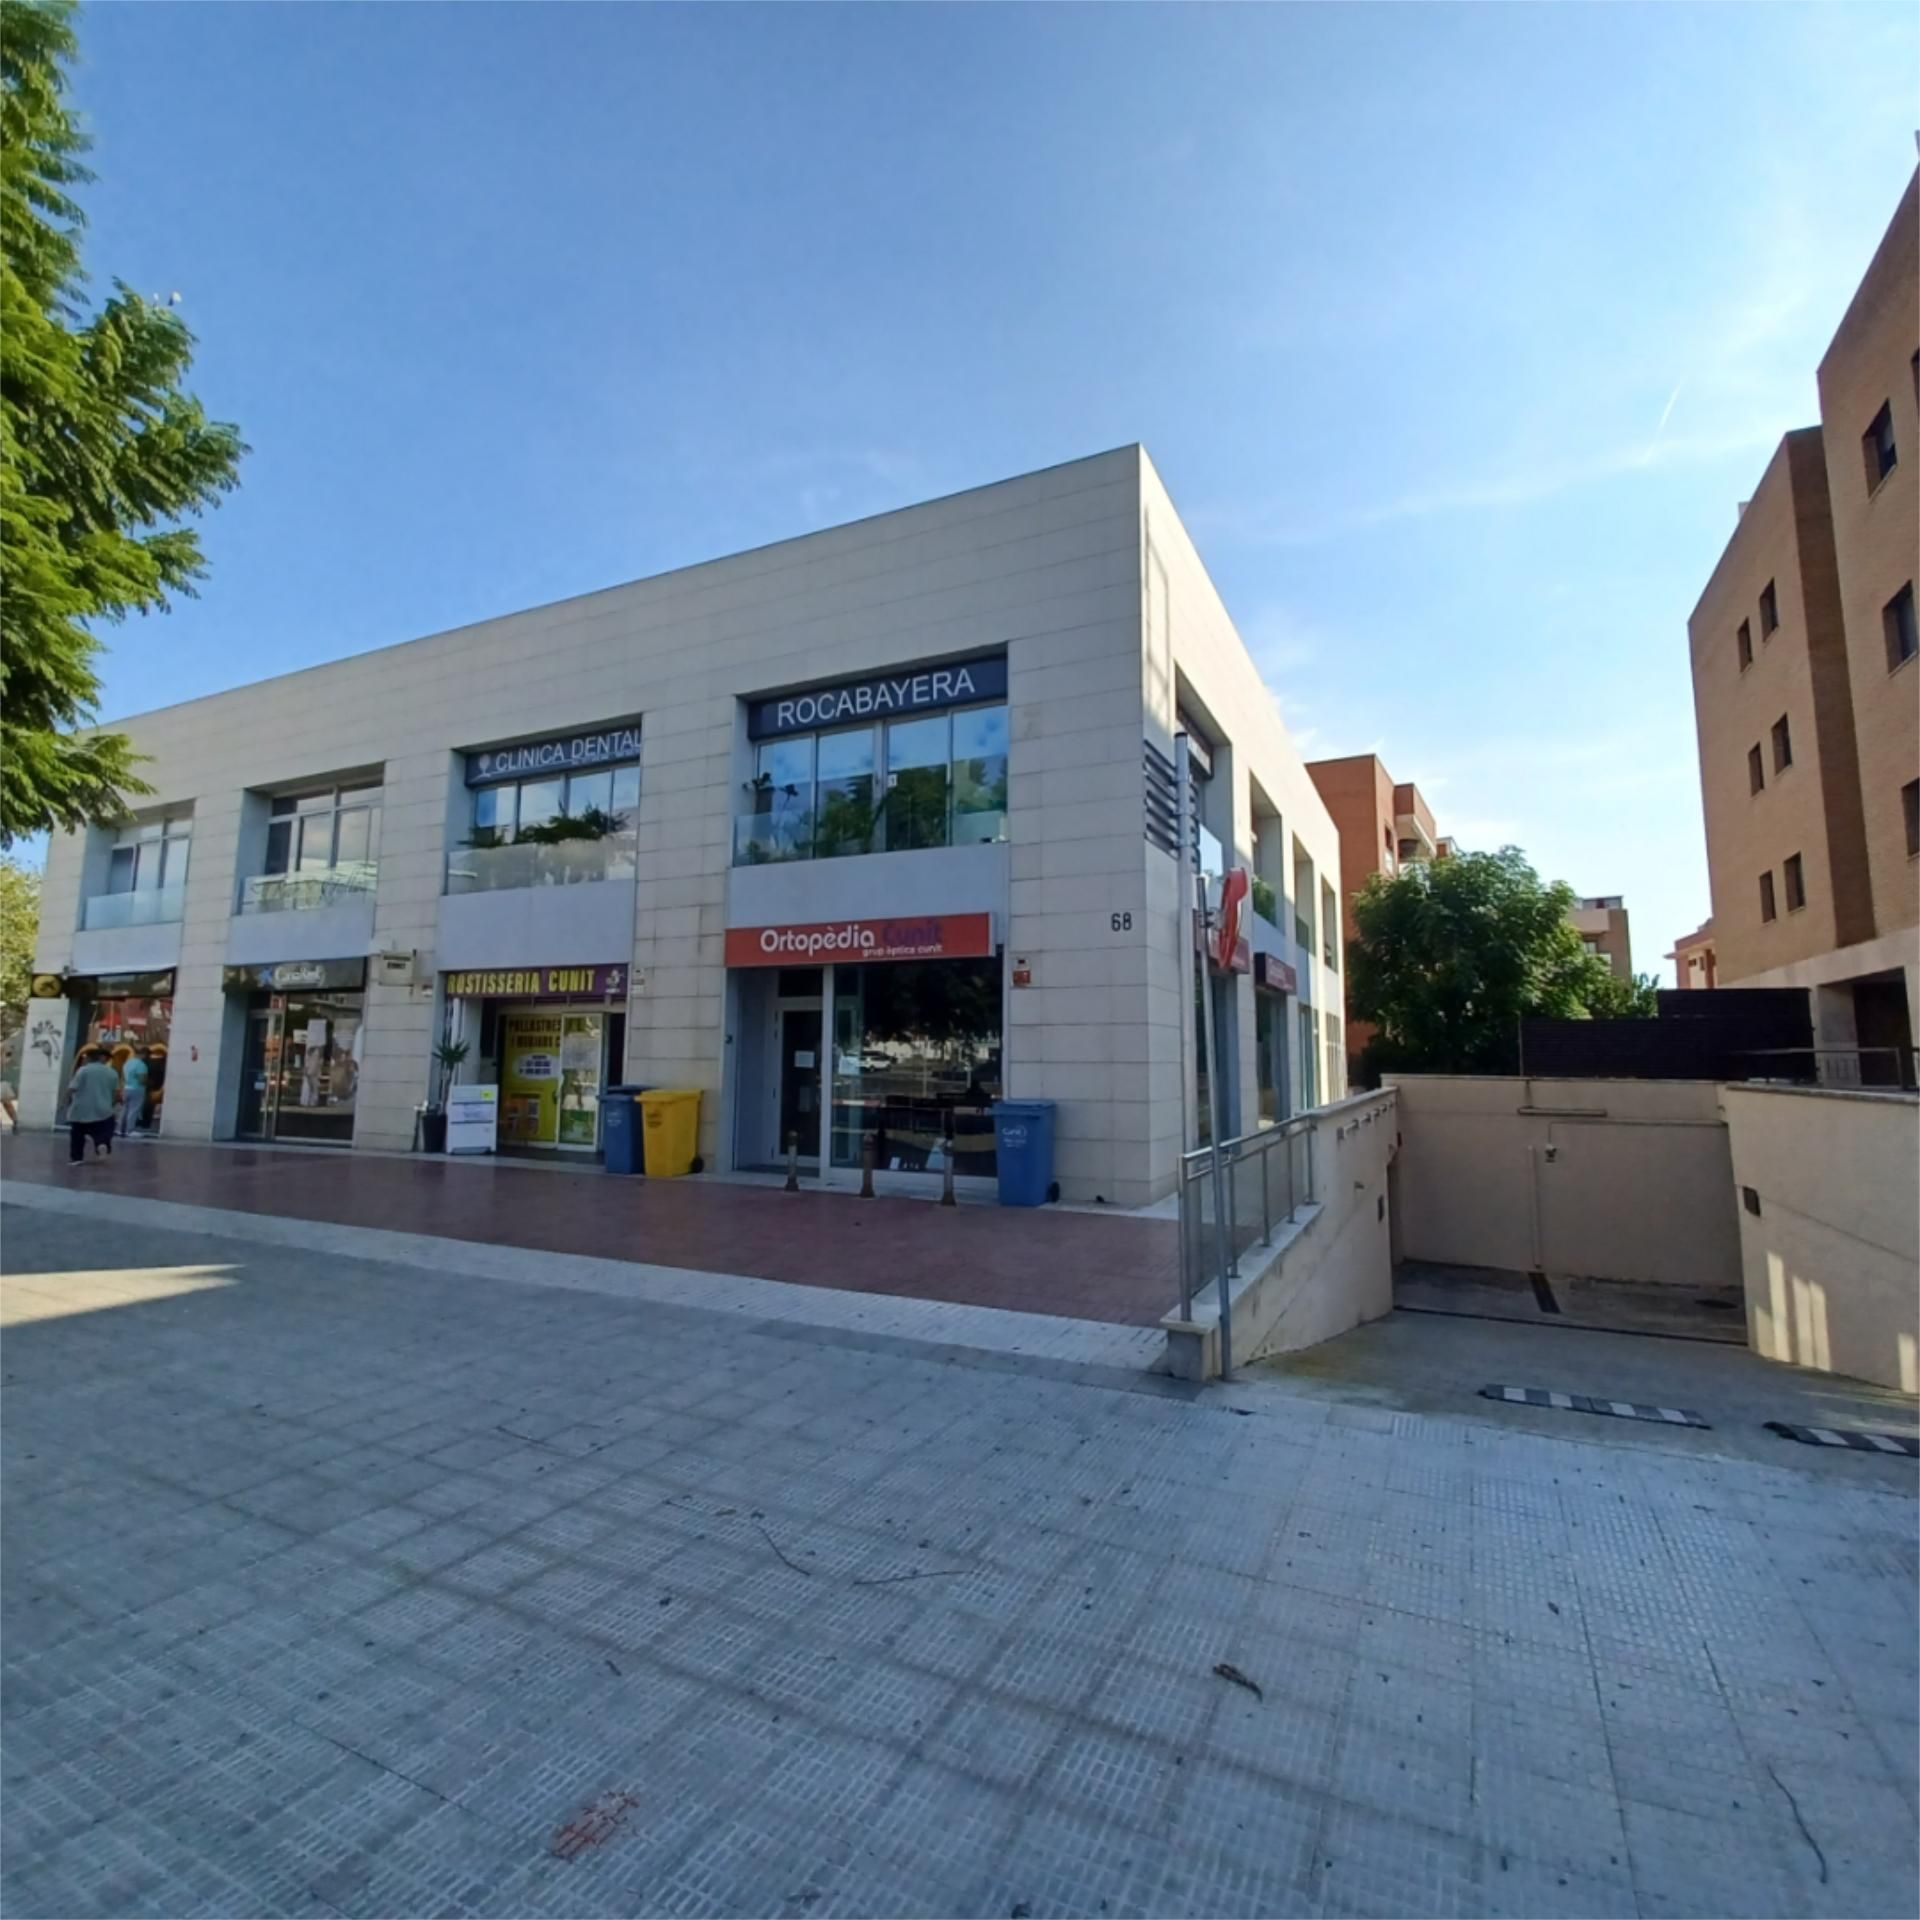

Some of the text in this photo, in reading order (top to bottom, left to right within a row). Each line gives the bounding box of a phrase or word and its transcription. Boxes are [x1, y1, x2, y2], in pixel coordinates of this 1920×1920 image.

[778, 668, 976, 728] ROCABAYERA
[495, 743, 564, 771] CLÍNICA
[571, 729, 641, 760] DENTAL
[760, 918, 942, 957] Ortopèdia Cunit
[1111, 911, 1132, 932] 68
[447, 969, 596, 995] ROSTISSERIA CUNIT
